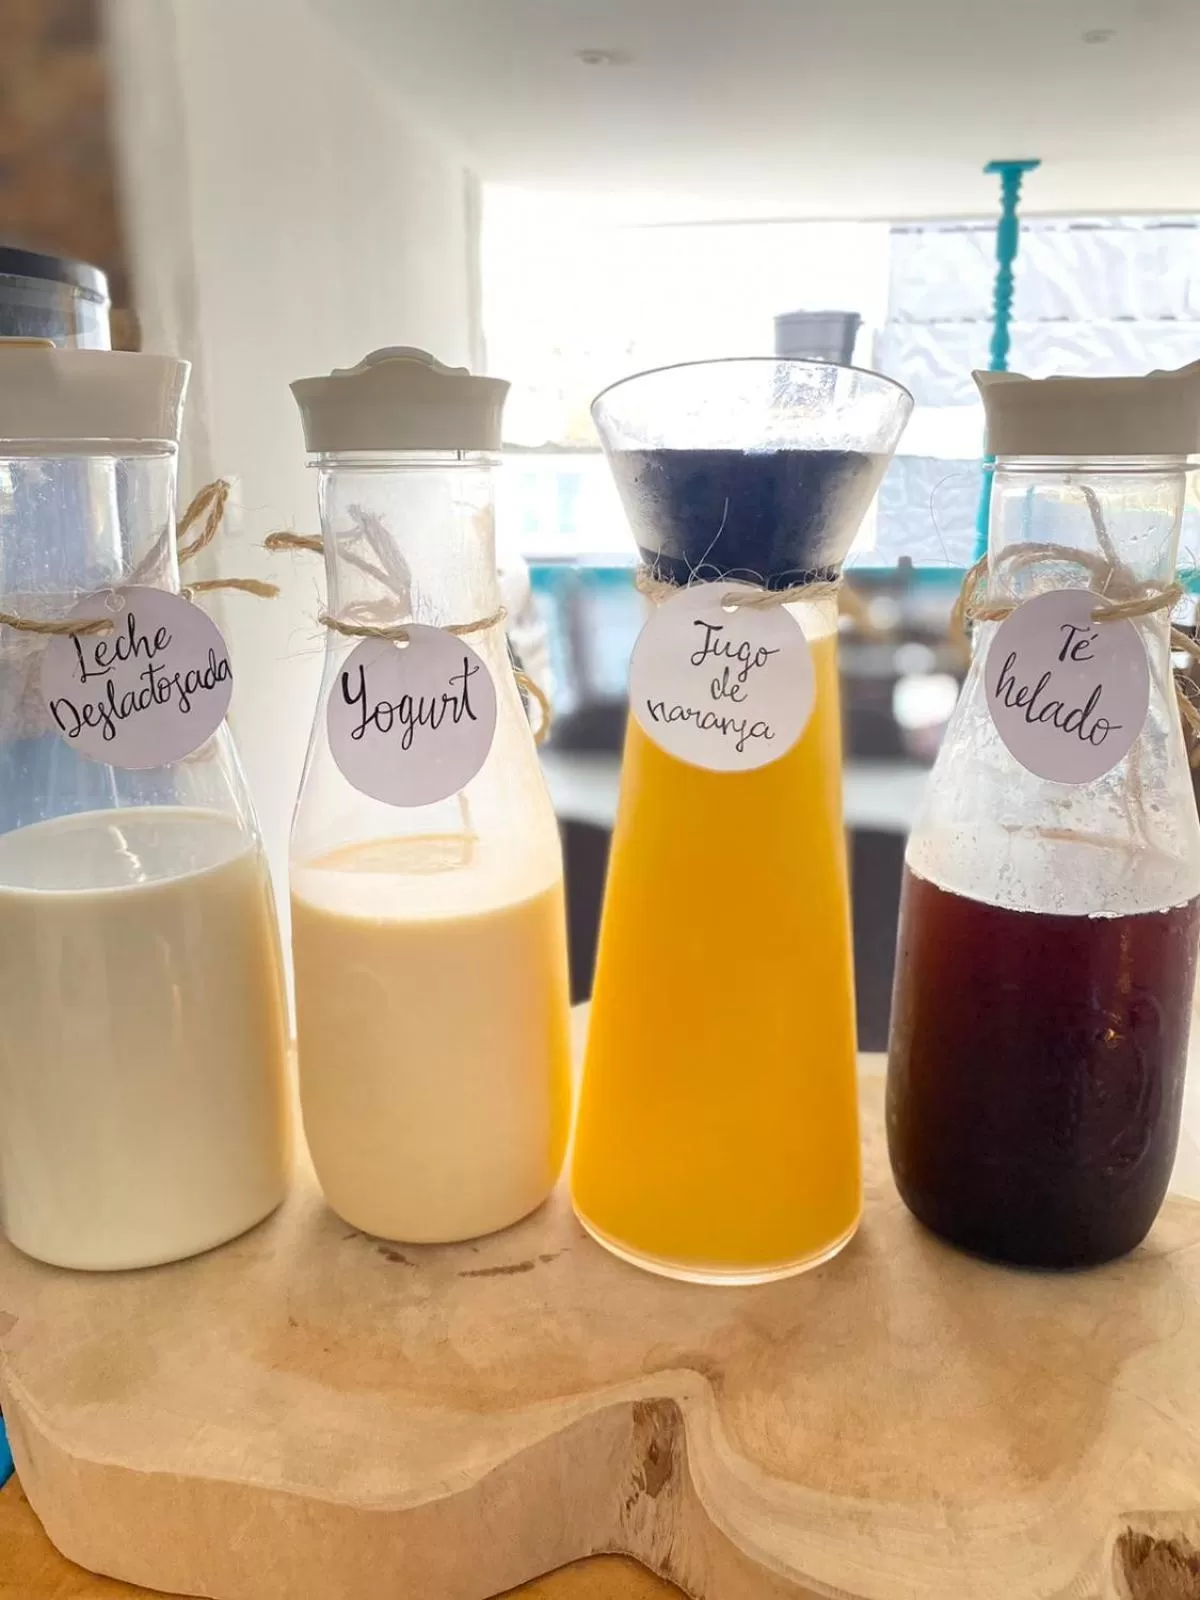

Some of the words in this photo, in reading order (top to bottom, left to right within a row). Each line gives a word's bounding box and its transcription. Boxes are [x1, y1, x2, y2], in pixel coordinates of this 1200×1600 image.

[69, 613, 173, 683] Leche
[690, 620, 780, 683] Jugo
[1058, 623, 1099, 662] Té
[50, 648, 233, 741] Deslactosada
[341, 656, 480, 750] Yogurt
[710, 666, 748, 703] de
[995, 651, 1123, 746] helado
[647, 699, 776, 753] naranja
